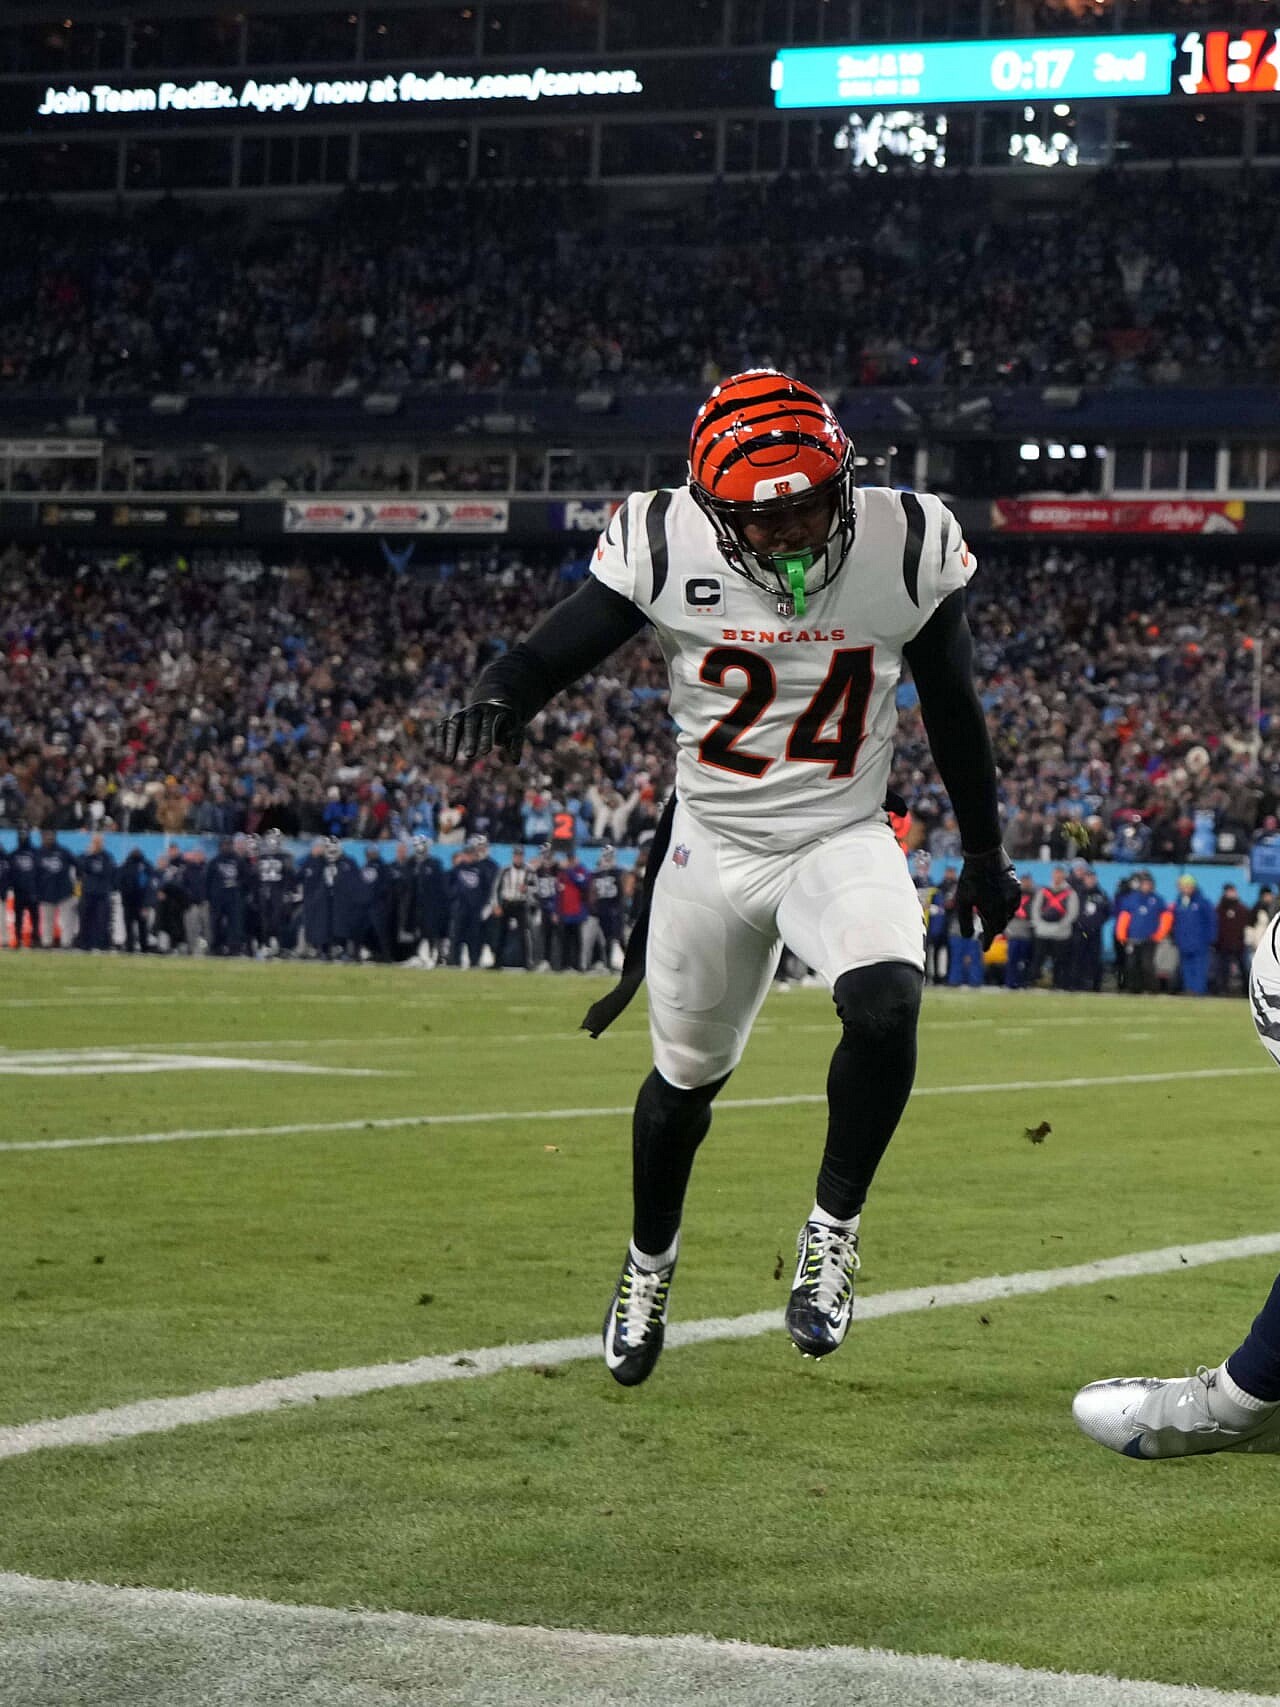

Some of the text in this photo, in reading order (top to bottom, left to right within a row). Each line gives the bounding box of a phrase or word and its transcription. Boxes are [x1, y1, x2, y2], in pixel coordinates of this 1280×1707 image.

[990, 48, 1075, 91] 0:17
[38, 86, 90, 114] Join
[92, 85, 156, 112] Team
[240, 77, 312, 112] Apply
[314, 80, 368, 104] now
[369, 74, 397, 102] at
[564, 500, 614, 530] Fed
[685, 578, 721, 606] C
[722, 628, 846, 644] BENGALS
[698, 645, 875, 780] 24
[553, 813, 573, 839] 2
